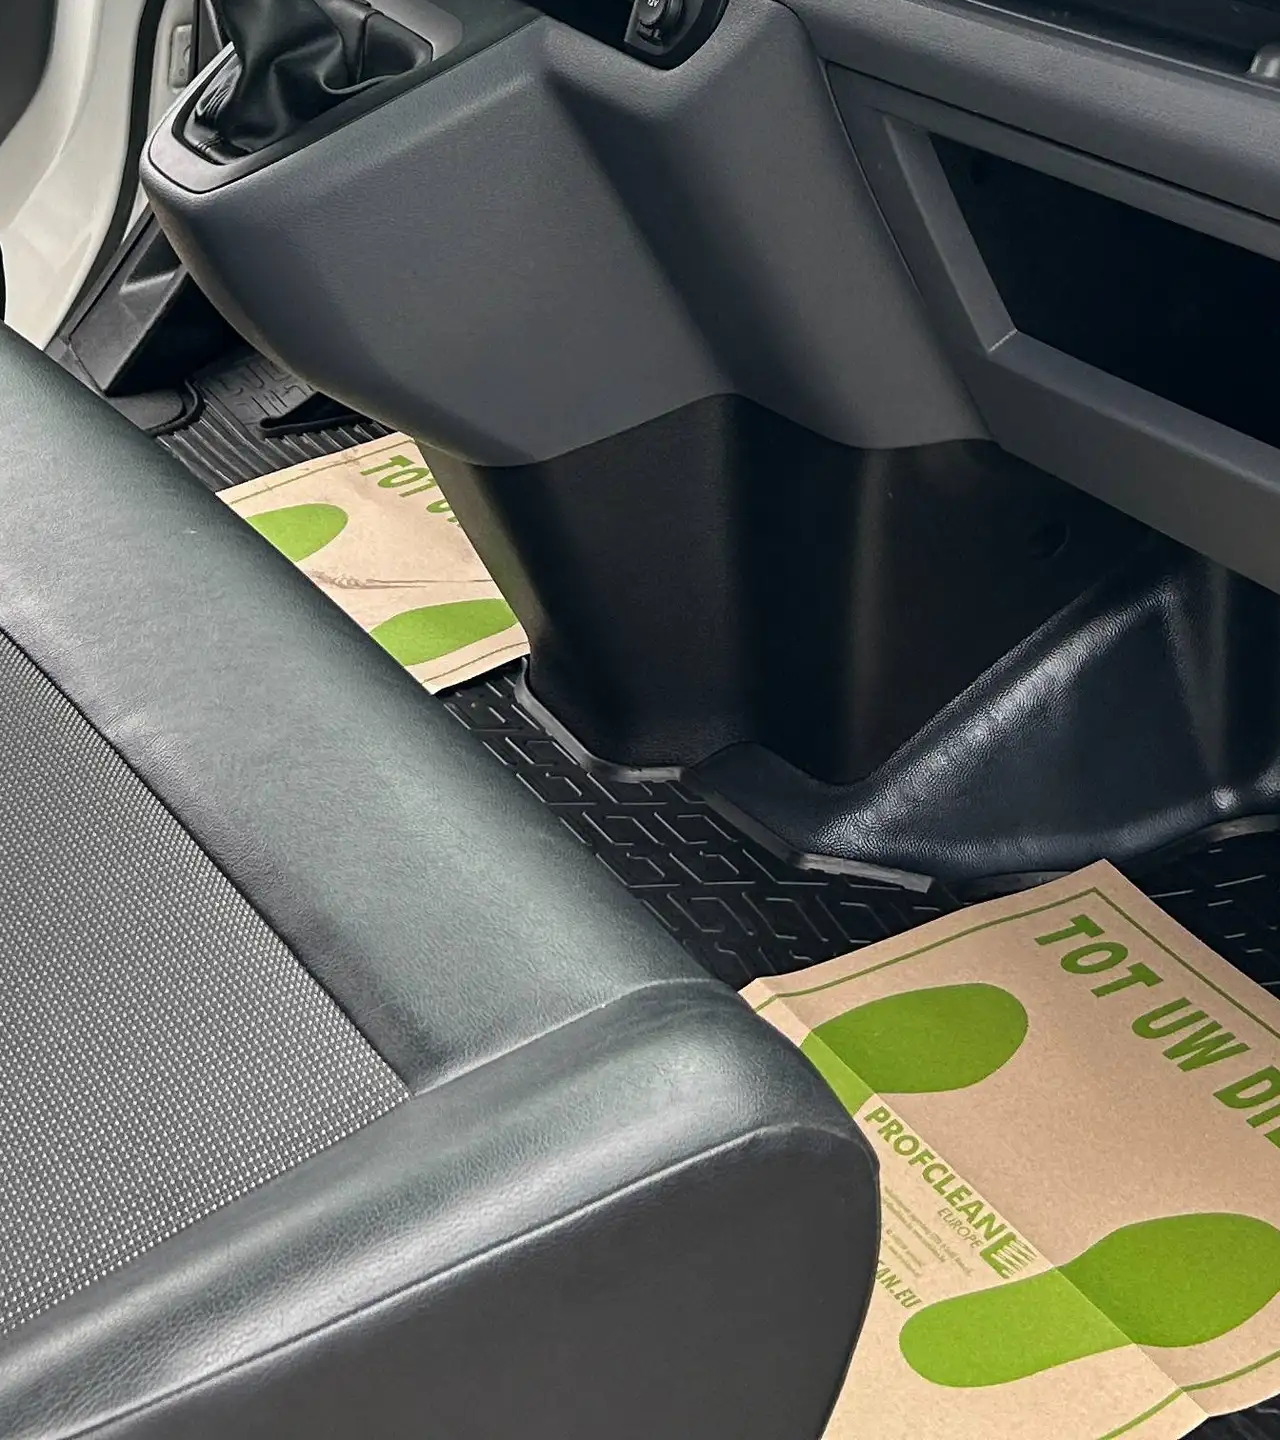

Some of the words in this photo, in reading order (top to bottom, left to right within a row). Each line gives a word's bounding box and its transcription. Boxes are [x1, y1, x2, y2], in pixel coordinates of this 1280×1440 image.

[1034, 913, 1164, 999] TOT
[1130, 997, 1250, 1073] UW
[937, 1207, 985, 1249] EUROPE
